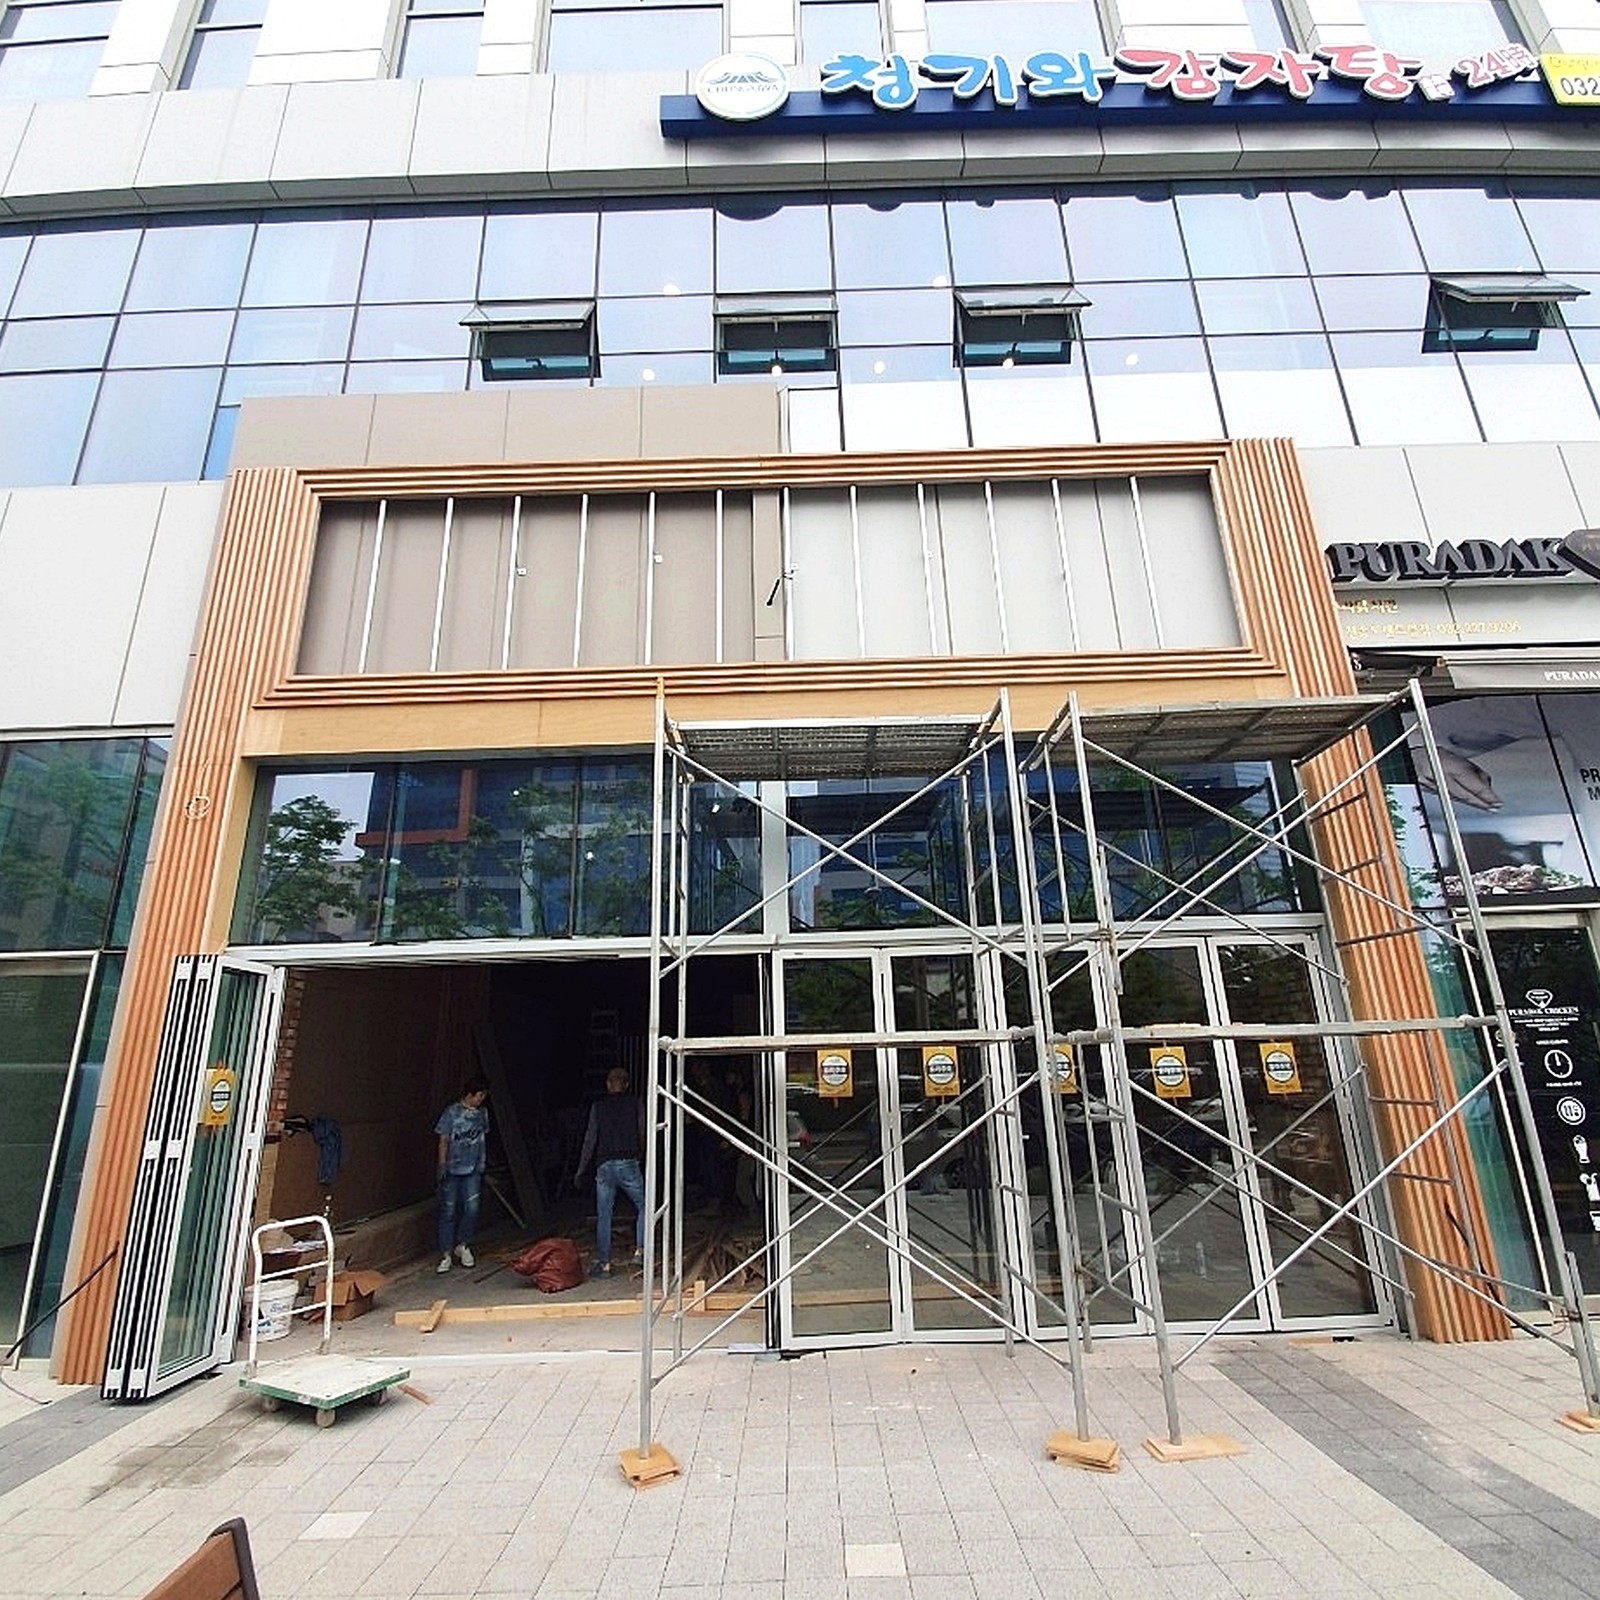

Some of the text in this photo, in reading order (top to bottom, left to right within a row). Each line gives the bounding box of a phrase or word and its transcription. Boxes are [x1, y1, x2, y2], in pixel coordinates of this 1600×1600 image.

[822, 51, 1115, 107] 청기와
[1116, 44, 1422, 99] 감자탕
[1326, 538, 1574, 581] PURADAK
[1544, 670, 1600, 681] PURADA
